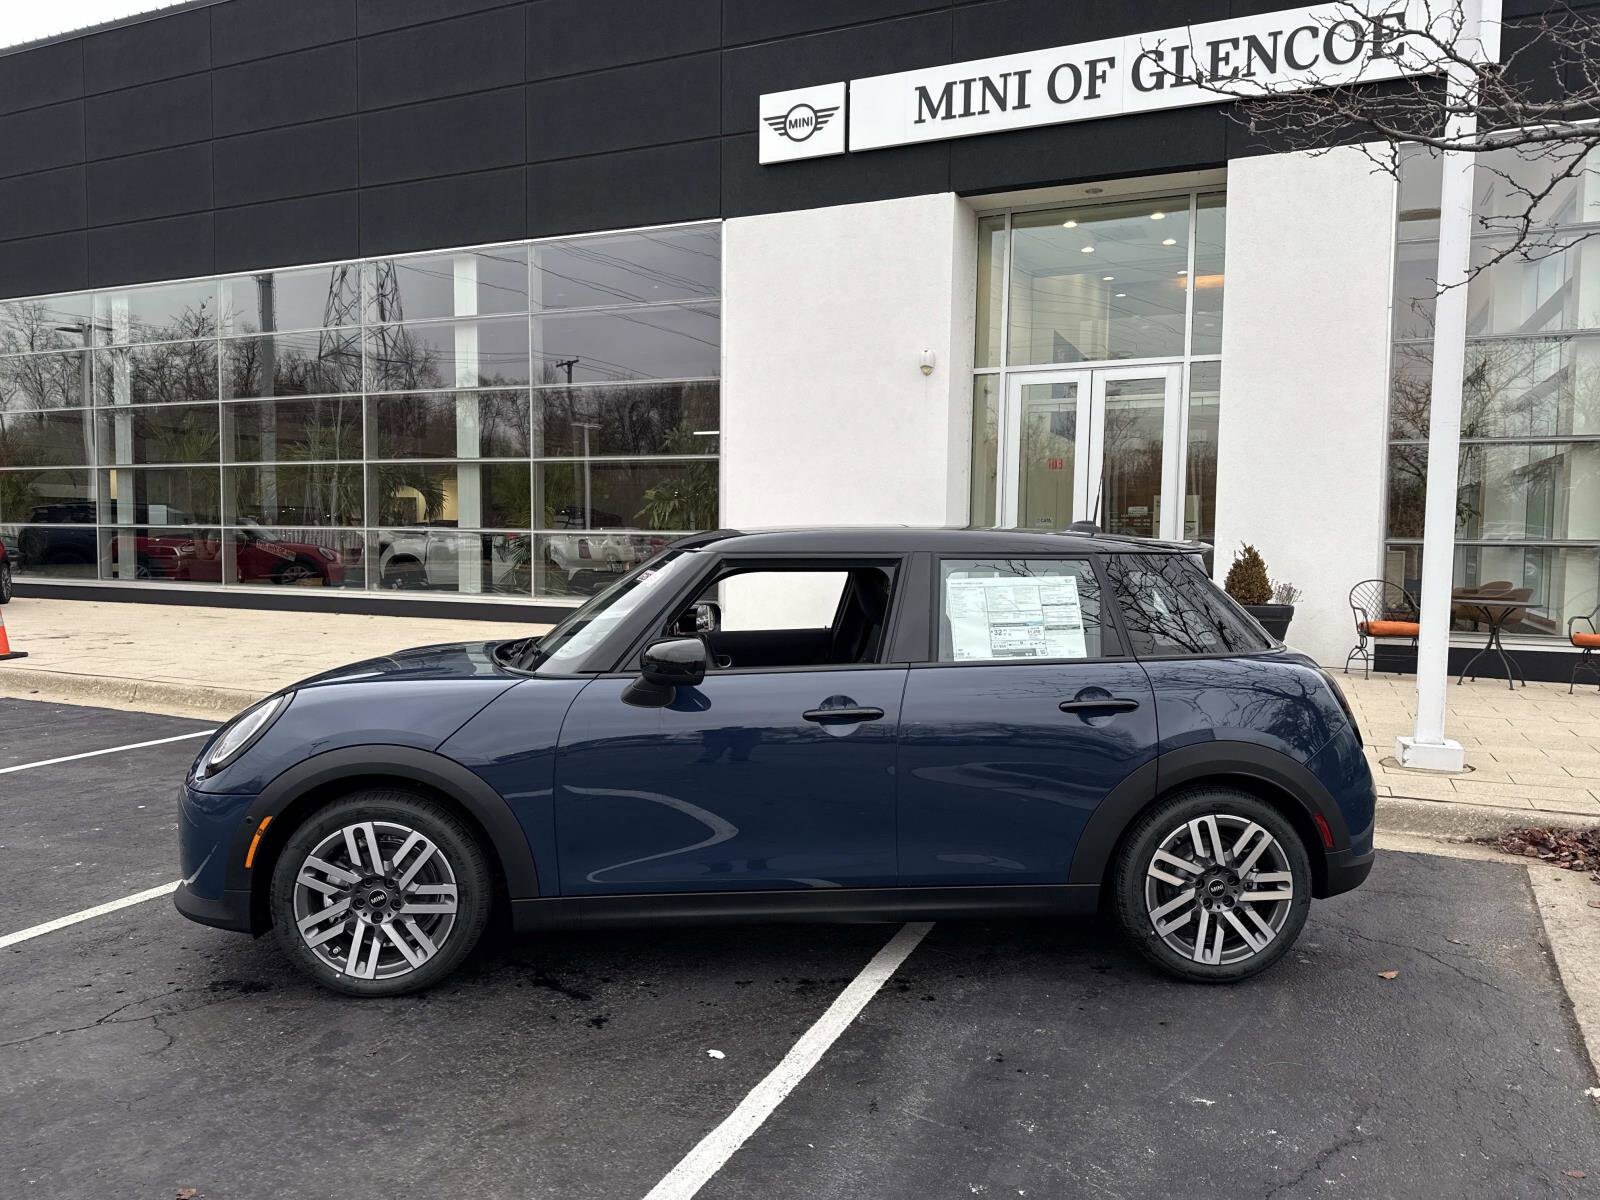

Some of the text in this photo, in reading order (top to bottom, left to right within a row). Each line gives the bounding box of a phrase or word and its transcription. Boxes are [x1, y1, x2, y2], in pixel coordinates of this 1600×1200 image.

[914, 12, 1406, 124] MINI OF GLENCOE
[788, 116, 814, 130] MINI
[1210, 884, 1223, 892] MINI
[370, 894, 385, 903] MINI
